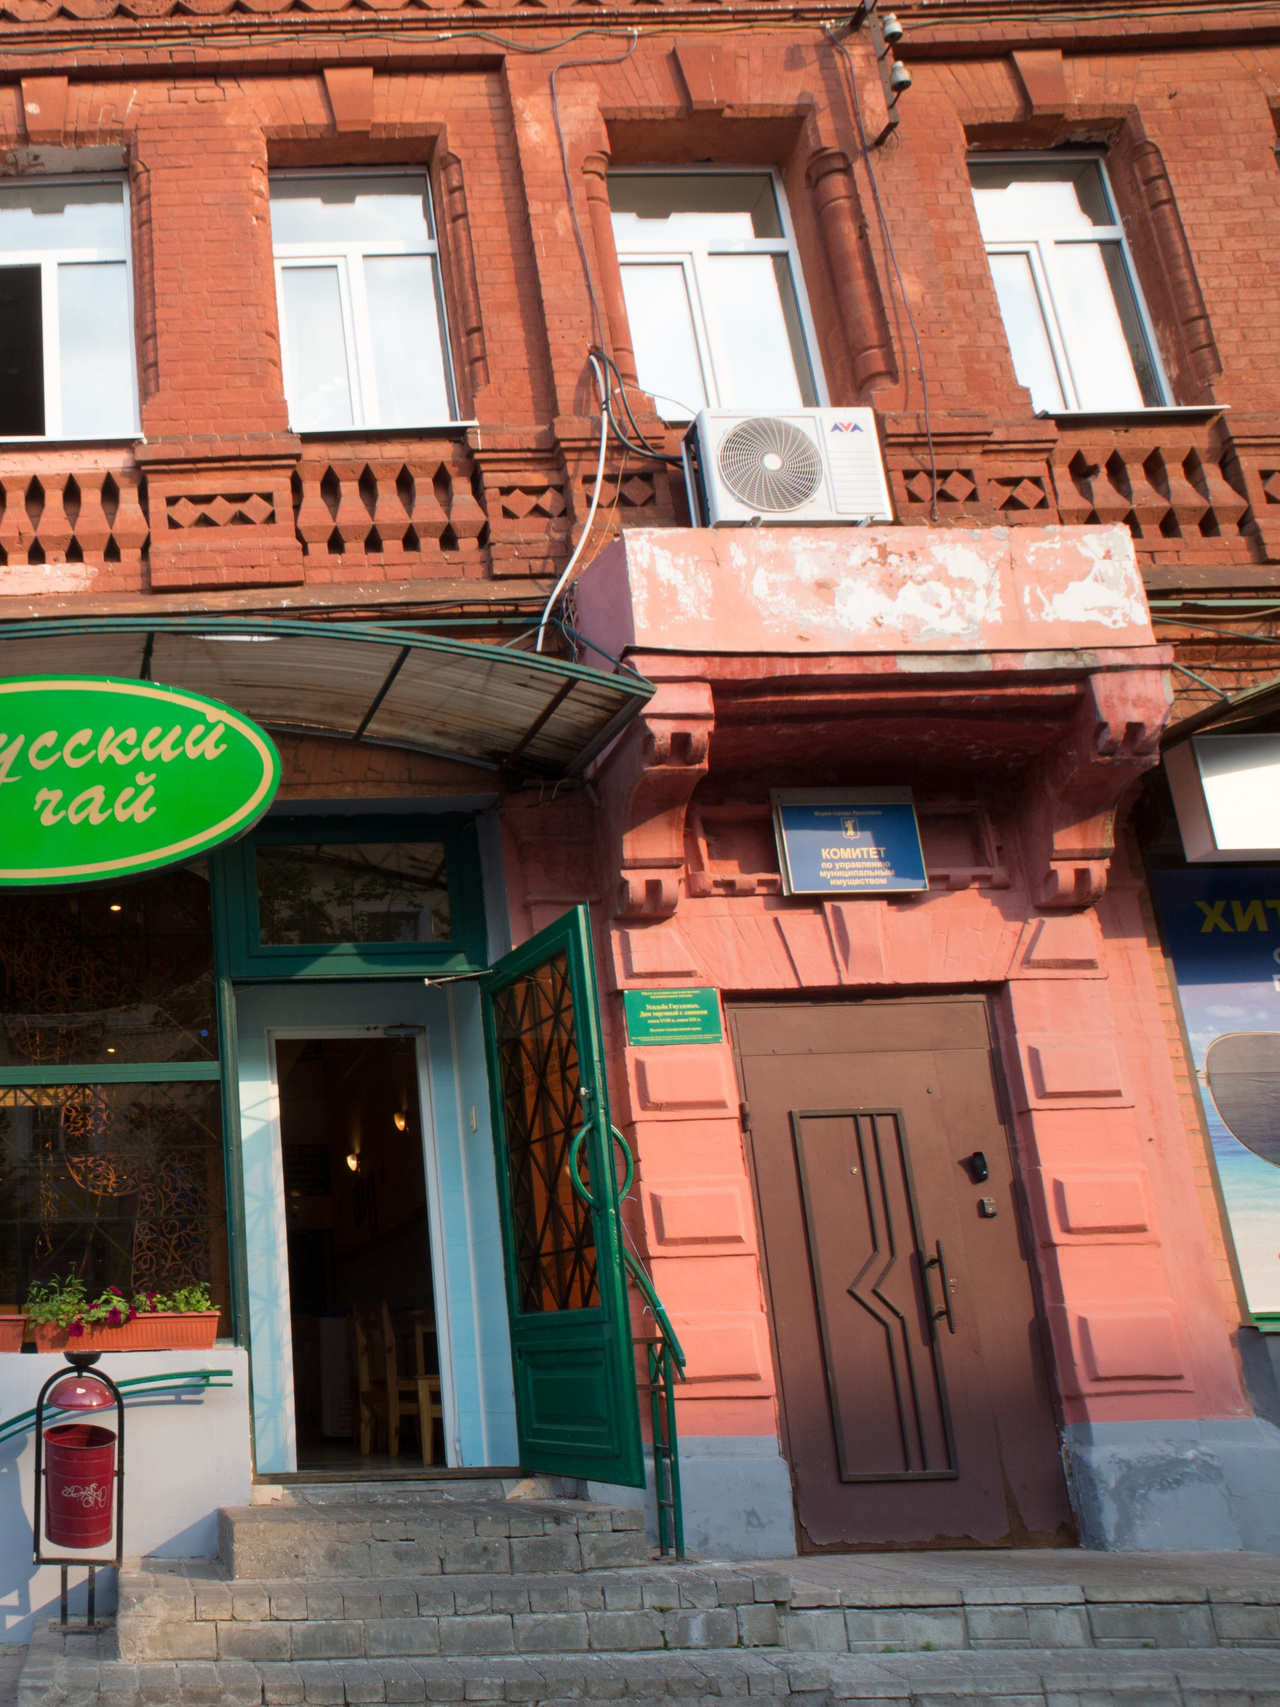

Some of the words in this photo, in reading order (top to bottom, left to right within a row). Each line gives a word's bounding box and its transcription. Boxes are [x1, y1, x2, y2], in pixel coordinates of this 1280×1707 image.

[33, 770, 158, 827] чай
[821, 847, 886, 860] КОМИТЕТ
[834, 861, 891, 870] управлению
[820, 869, 895, 879] муниципальным
[830, 877, 888, 887] имуществом
